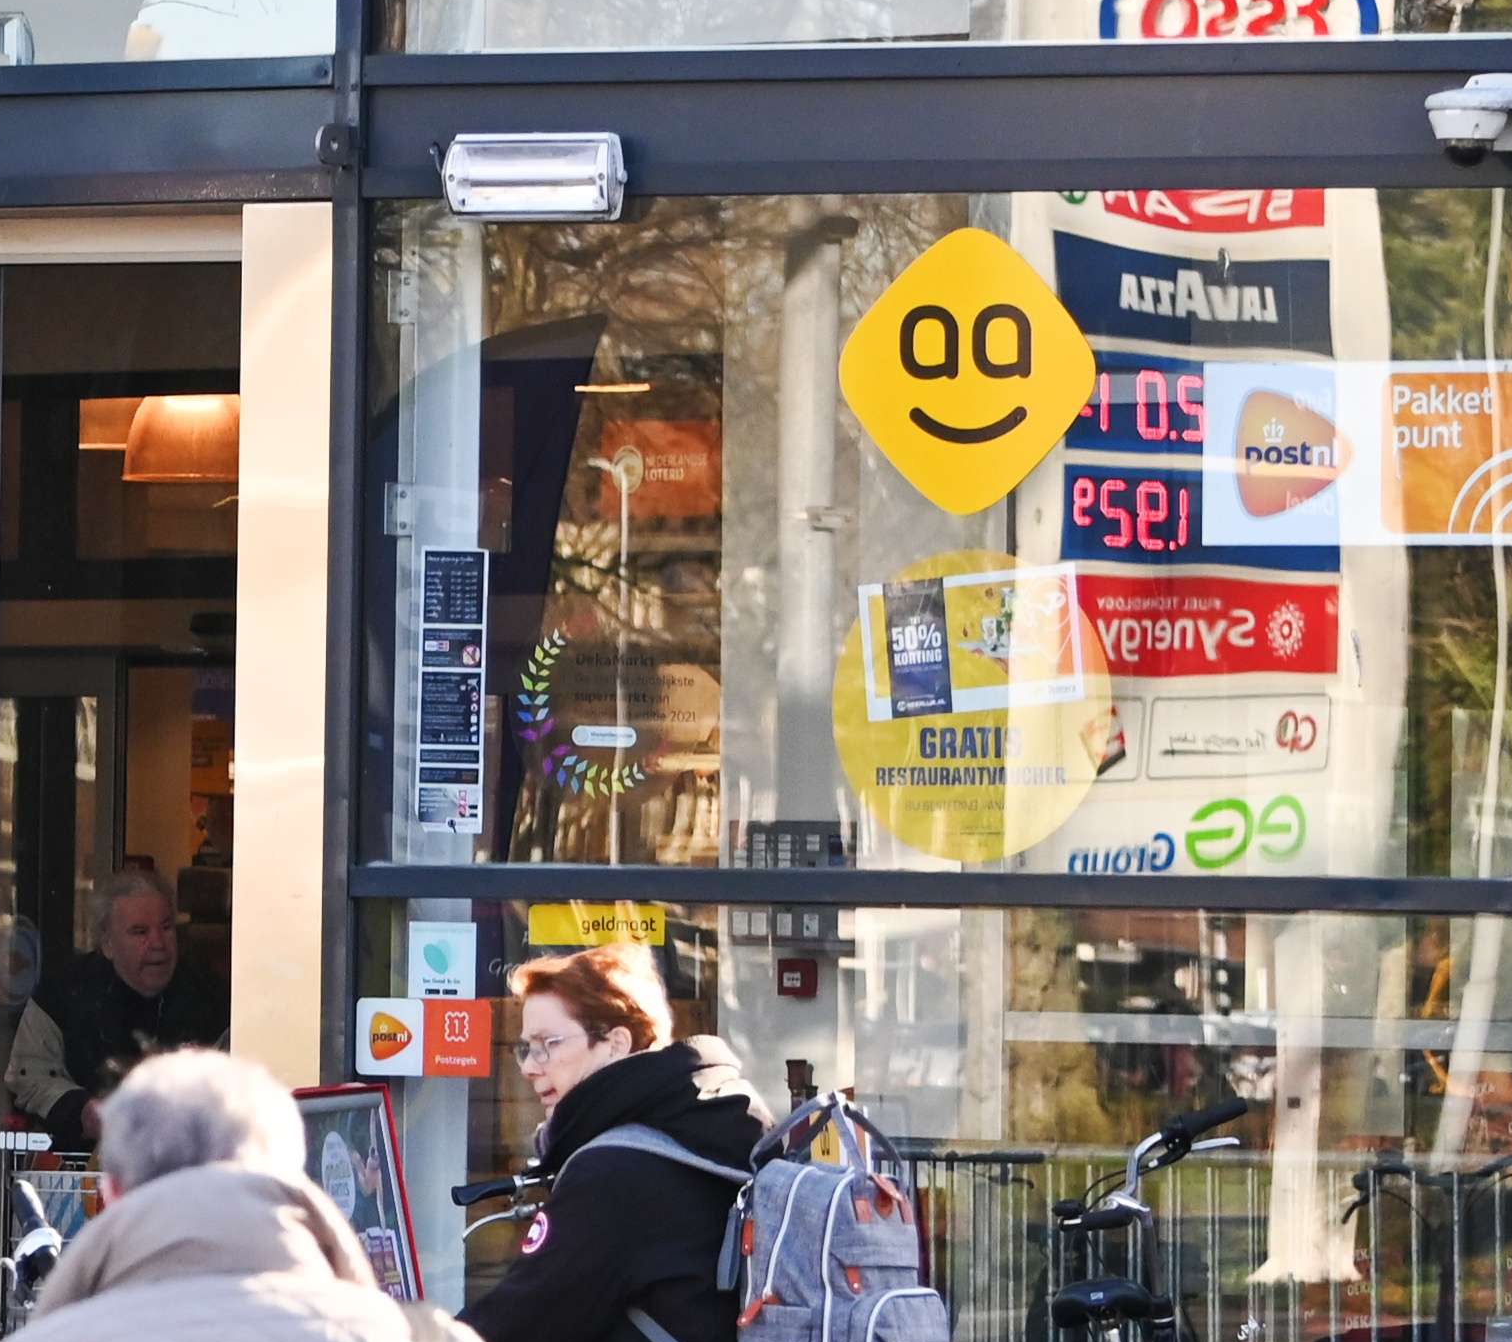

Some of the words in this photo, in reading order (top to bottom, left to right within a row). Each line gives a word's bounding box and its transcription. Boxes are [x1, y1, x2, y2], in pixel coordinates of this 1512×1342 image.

[1393, 384, 1494, 415] Pakket
[1393, 420, 1463, 451] punt
[1245, 440, 1339, 474] postnl
[645, 467, 684, 481] LOTERIJ
[891, 622, 942, 652] 50%
[894, 649, 943, 667] KORTING
[670, 710, 696, 722] 2021
[919, 726, 1022, 760] GRATIS
[876, 766, 1067, 786] RESTAURANTVOUCHER
[581, 916, 657, 935] geldmaat
[372, 1029, 408, 1045] postnl
[434, 1054, 478, 1067] Postzegels
